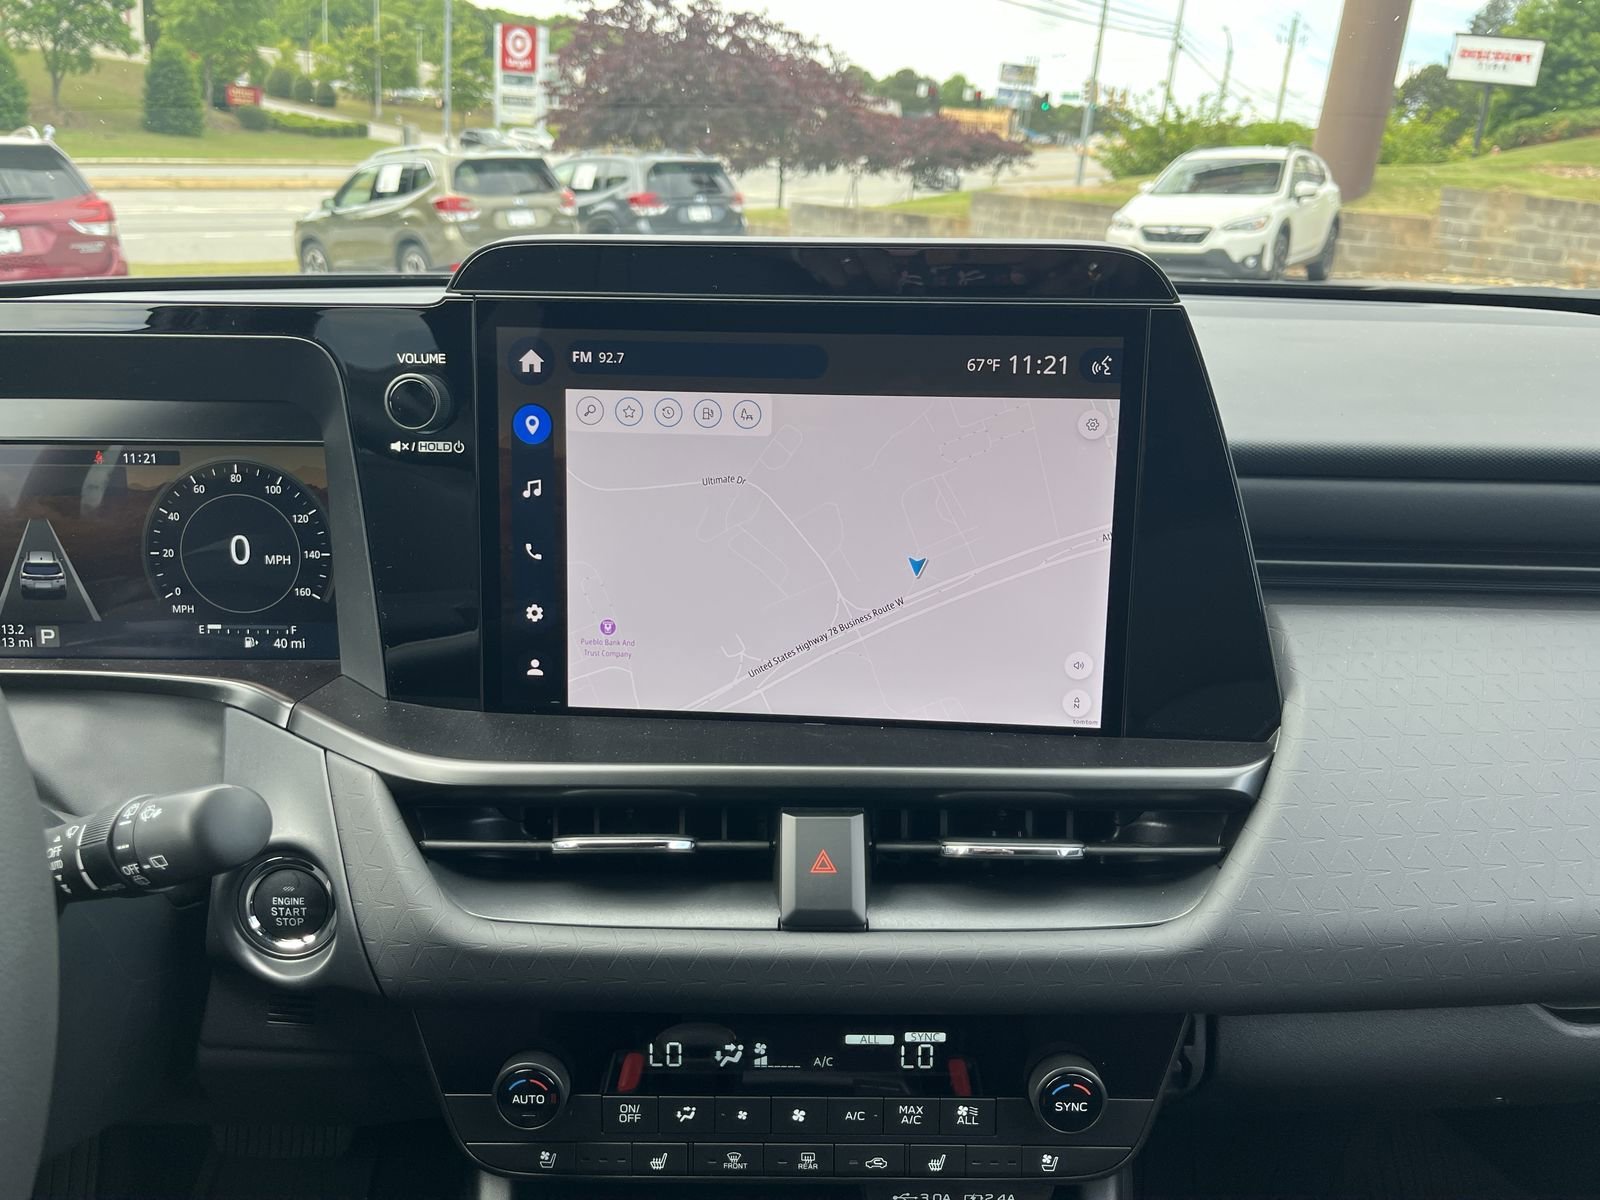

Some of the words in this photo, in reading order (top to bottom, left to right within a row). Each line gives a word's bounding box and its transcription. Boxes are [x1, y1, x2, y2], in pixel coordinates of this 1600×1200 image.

[397, 353, 446, 363] VOLUME
[573, 351, 591, 362] FM
[599, 352, 624, 363] 92.7
[1010, 355, 1066, 374] 11:21
[420, 442, 450, 452] HOLD
[123, 453, 155, 463] 11:21
[231, 474, 241, 482] 80
[702, 475, 735, 486] Ultimate
[736, 475, 747, 485] Dr
[194, 485, 205, 493] 60
[266, 486, 281, 494] 100
[168, 512, 180, 521] 40
[293, 514, 309, 523] 120
[163, 549, 174, 557] 20
[231, 535, 250, 564] 0
[265, 555, 290, 564] MPH
[304, 551, 320, 559] 140
[175, 587, 181, 595] 0
[295, 588, 311, 596] 160
[173, 605, 194, 613] MPH
[2, 625, 24, 634] 13.2
[41, 630, 55, 644] P
[748, 660, 773, 677] United
[772, 649, 796, 664] States
[795, 633, 829, 654] Highway
[828, 626, 839, 637] 78
[838, 612, 872, 632] Business
[872, 602, 896, 617] Route
[895, 597, 904, 606] W
[2, 638, 14, 647] 13
[274, 638, 287, 648] 40
[293, 638, 305, 648] mi
[580, 638, 603, 646] Pueblo
[604, 638, 621, 646] Bank
[622, 639, 636, 647] And
[584, 649, 600, 657] Trust
[601, 650, 632, 660] Company
[122, 863, 140, 875] OFF
[273, 897, 304, 905] ENGINE
[271, 907, 306, 916] START
[276, 918, 304, 926] STOP
[859, 1035, 880, 1044] ALL
[910, 1032, 940, 1042] SYNC
[814, 1056, 833, 1067] A/C
[512, 1095, 544, 1104] AUTO
[619, 1104, 641, 1114] ON/
[899, 1106, 923, 1114] MAX
[1056, 1102, 1087, 1111] SYNC
[618, 1114, 642, 1123] OFF
[845, 1112, 865, 1120] A/C
[901, 1115, 921, 1124] A/C
[957, 1115, 979, 1125] ALL
[723, 1162, 748, 1170] FRONT
